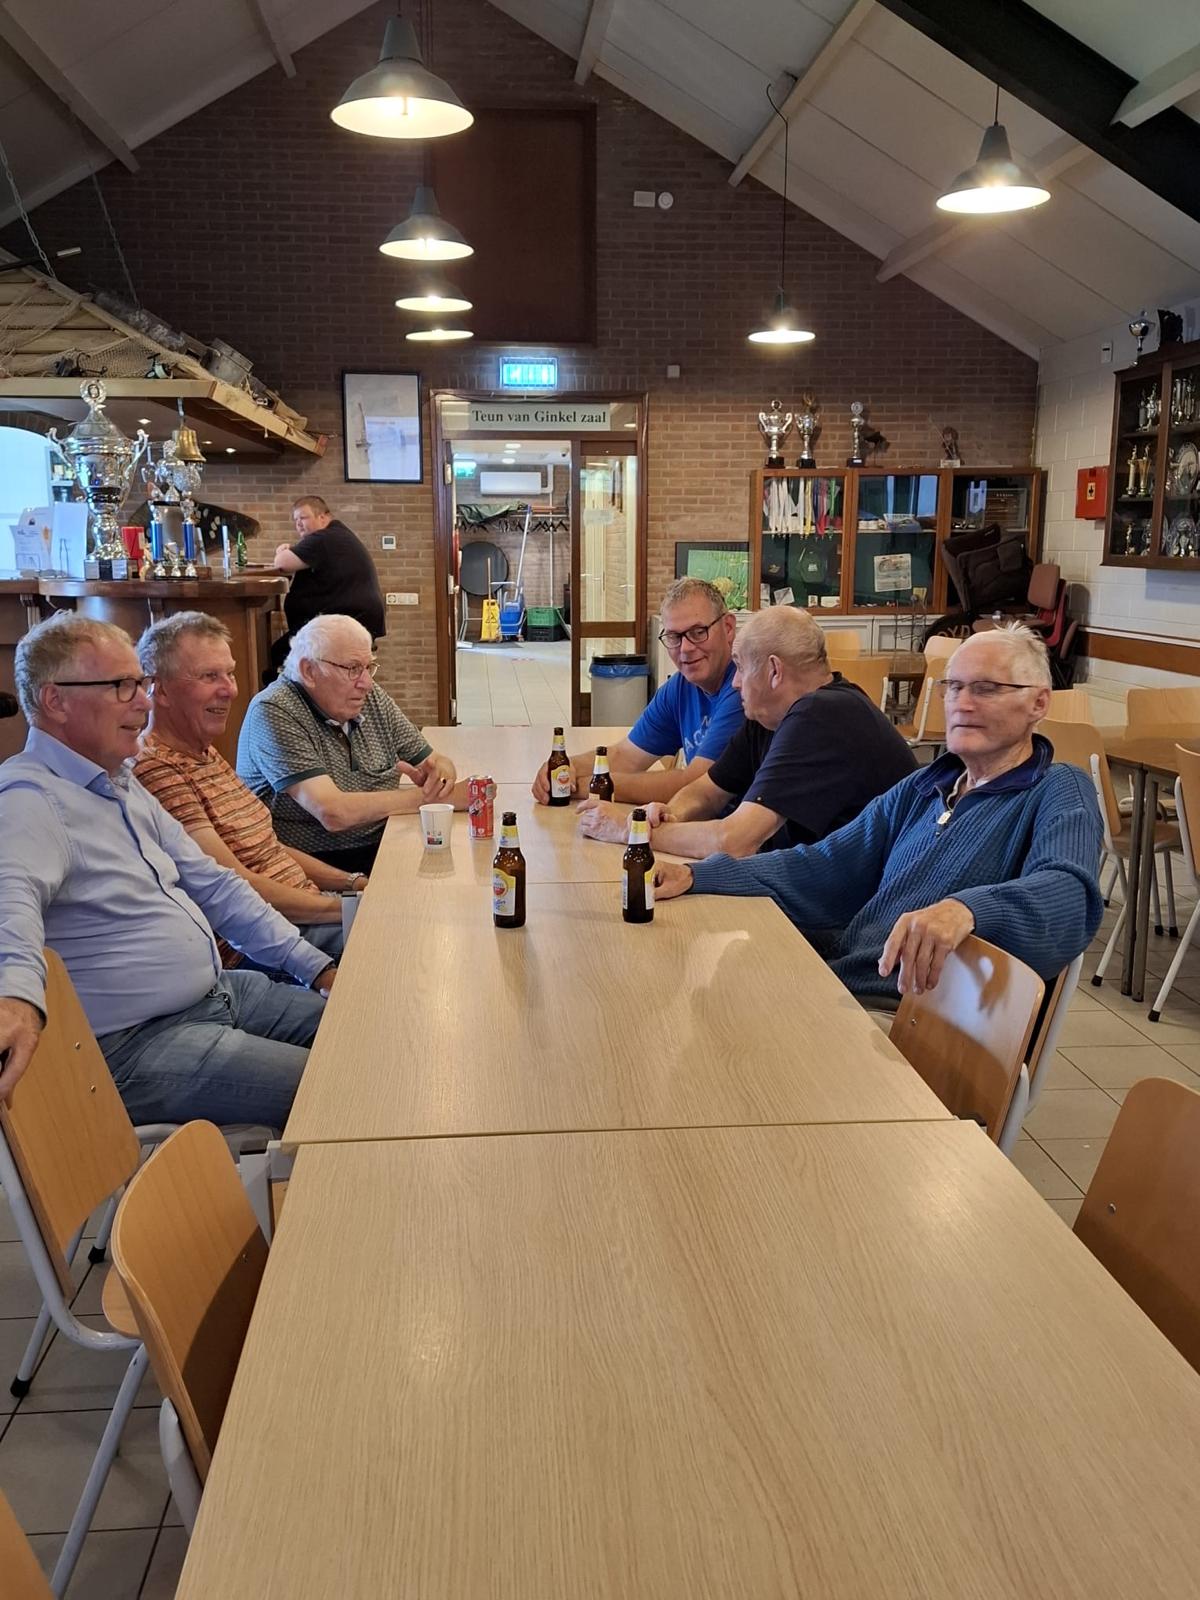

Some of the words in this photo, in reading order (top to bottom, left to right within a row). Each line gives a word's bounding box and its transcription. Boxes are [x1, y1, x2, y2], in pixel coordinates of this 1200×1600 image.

[472, 410, 504, 422] Teun
[508, 412, 530, 422] van
[534, 410, 577, 423] Ginkel
[580, 411, 606, 423] zaal
